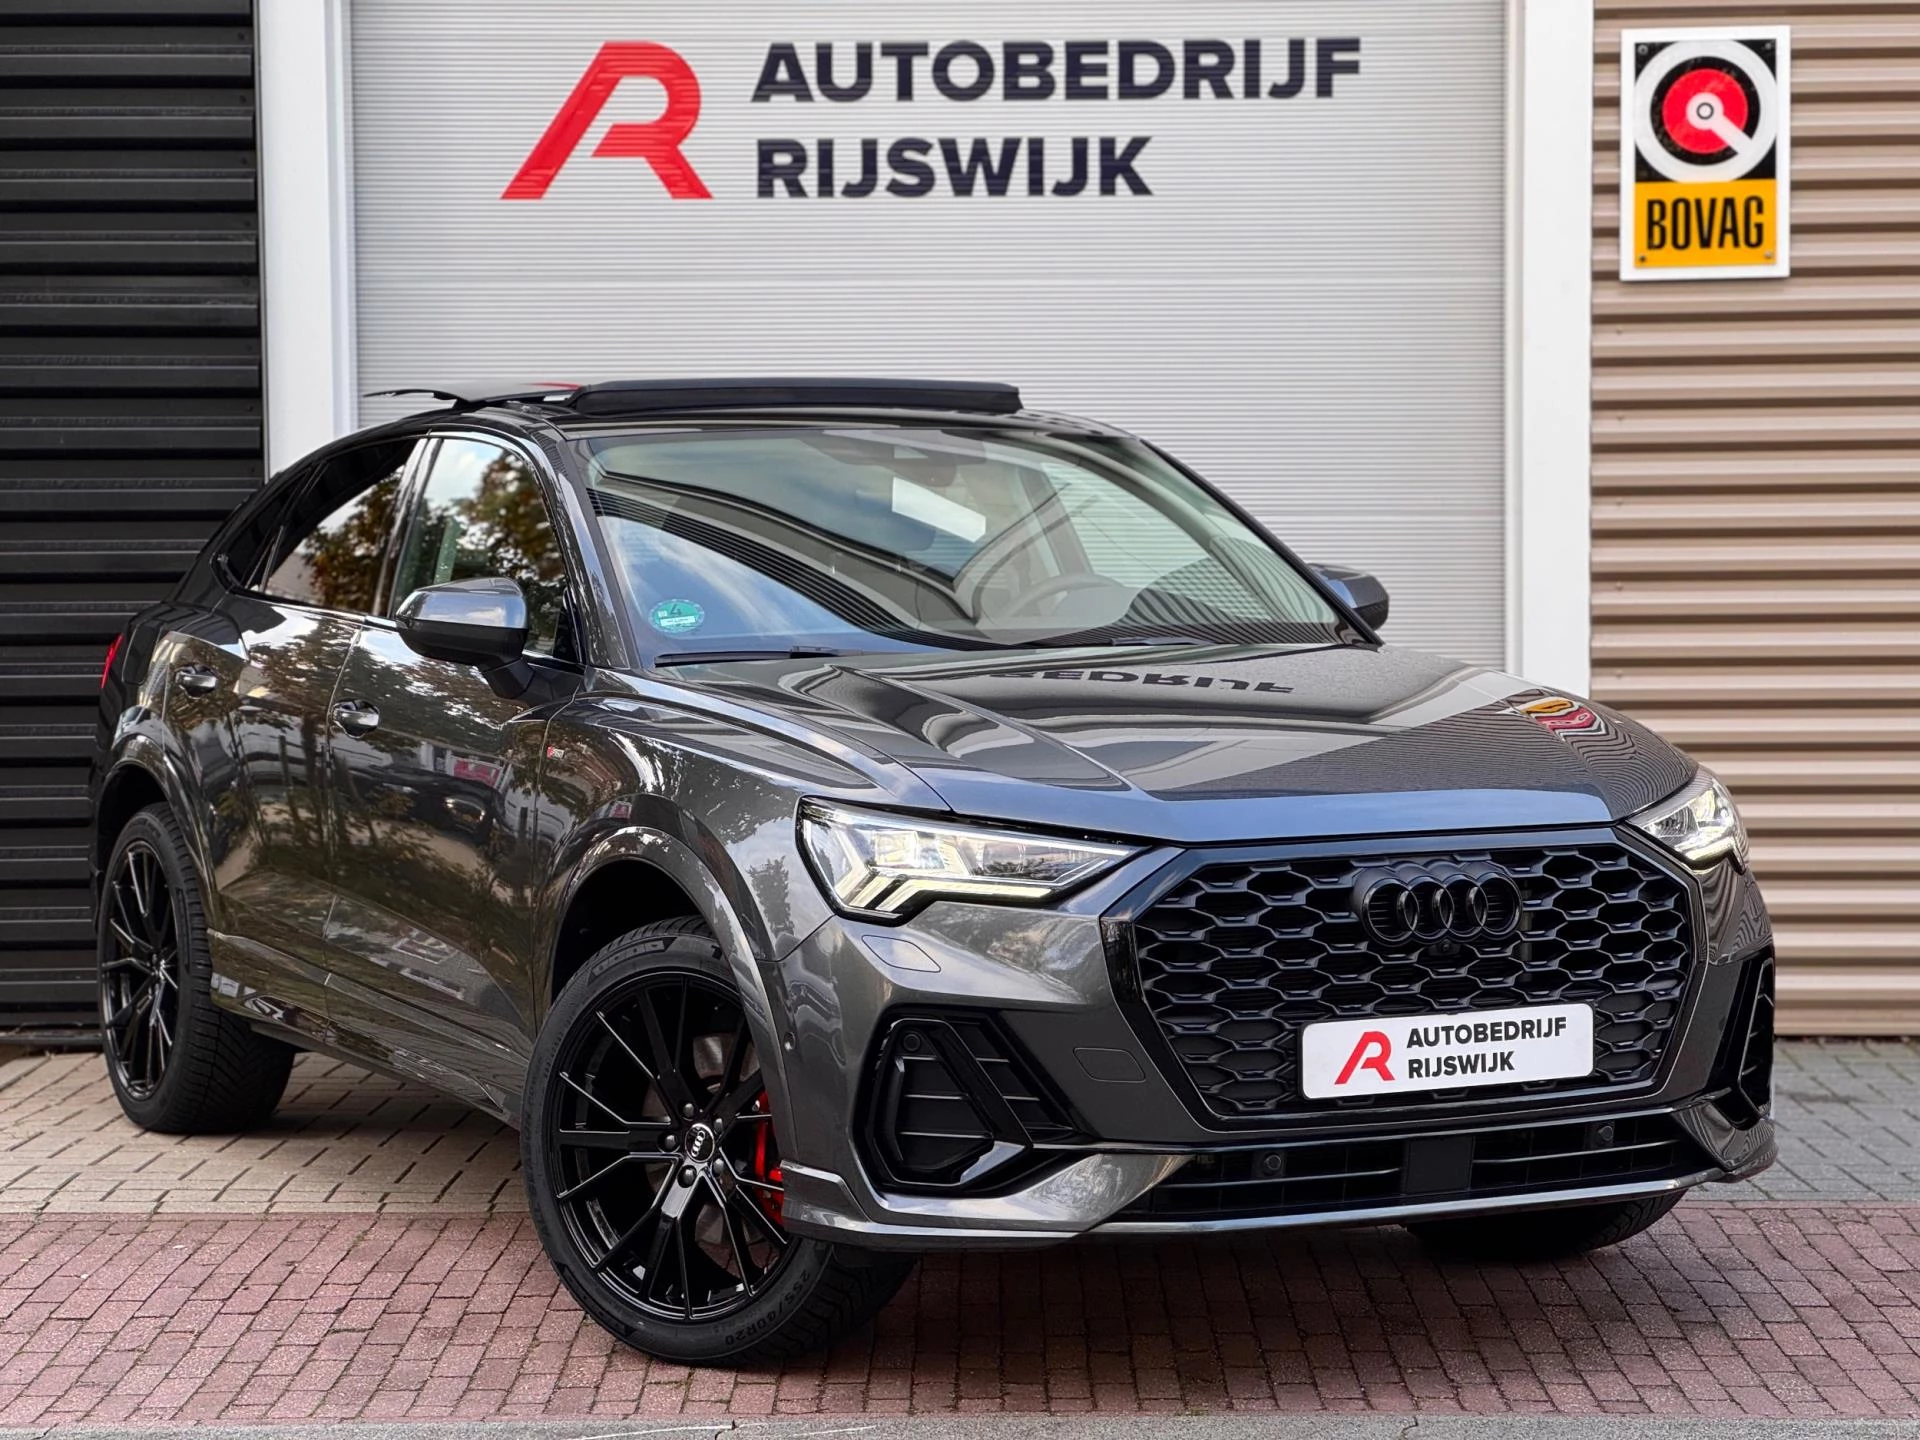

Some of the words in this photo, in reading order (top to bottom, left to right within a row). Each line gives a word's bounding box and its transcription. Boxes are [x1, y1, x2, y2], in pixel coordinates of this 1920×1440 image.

[752, 37, 1361, 103] AUTOBEDRIJF
[757, 136, 1154, 198] RIJSWIJK
[1647, 195, 1764, 251] BOVAG
[1407, 1016, 1567, 1049] AUTOBEDRIJF
[1408, 1051, 1515, 1079] RIJSWIJK
